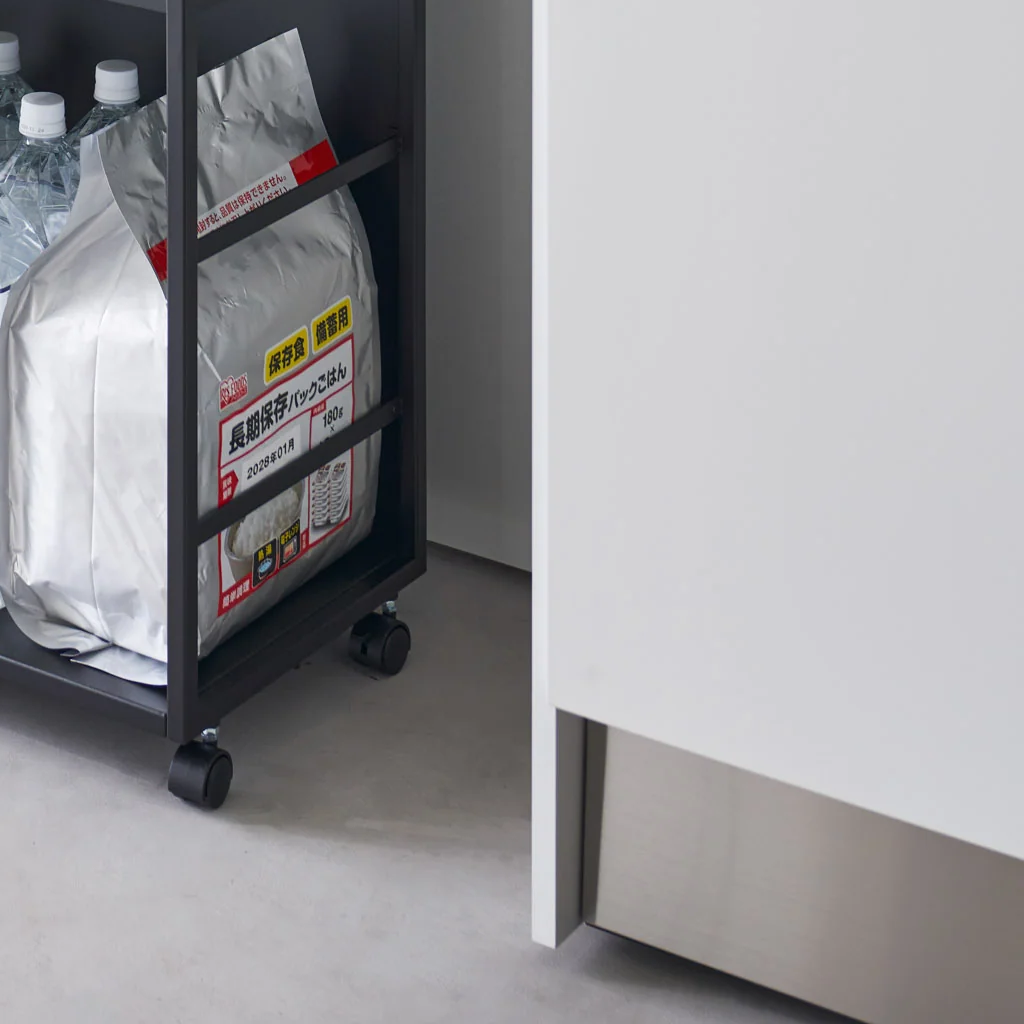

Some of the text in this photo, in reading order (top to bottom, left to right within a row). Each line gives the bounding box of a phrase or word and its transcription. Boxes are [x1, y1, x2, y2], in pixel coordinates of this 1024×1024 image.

[315, 305, 349, 347] 備蓄用
[268, 336, 305, 377] 保存食
[322, 405, 344, 428] 180g
[246, 437, 295, 480] 2028年01月
